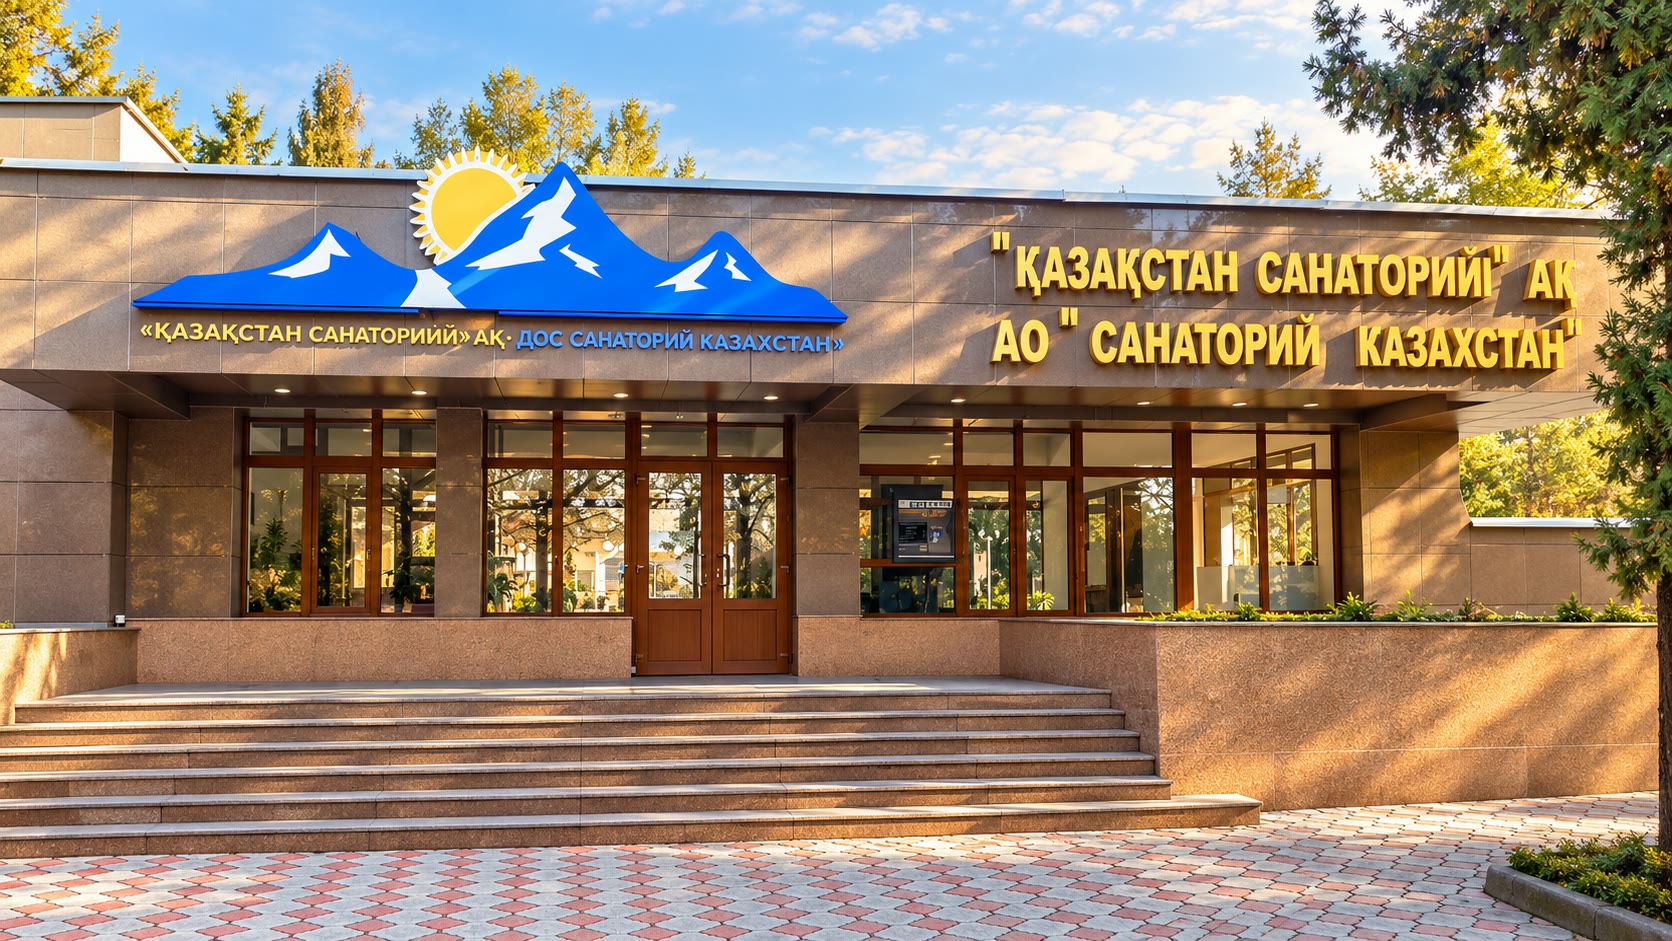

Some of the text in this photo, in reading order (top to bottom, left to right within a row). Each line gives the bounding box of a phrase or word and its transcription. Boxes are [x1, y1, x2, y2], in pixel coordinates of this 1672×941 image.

[991, 231, 1239, 299] "ҚАЗАҚСТАН
[1524, 254, 1576, 309] АҚ
[140, 322, 302, 345] «ҚАЗАҚСТАН
[516, 330, 563, 350] ДОС
[569, 329, 694, 351] САНАТОРИЙ
[700, 334, 844, 354] КАЗАХСТАН»
[991, 319, 1050, 363] АО
[1356, 316, 1583, 370] КАЗАХСТАН"
